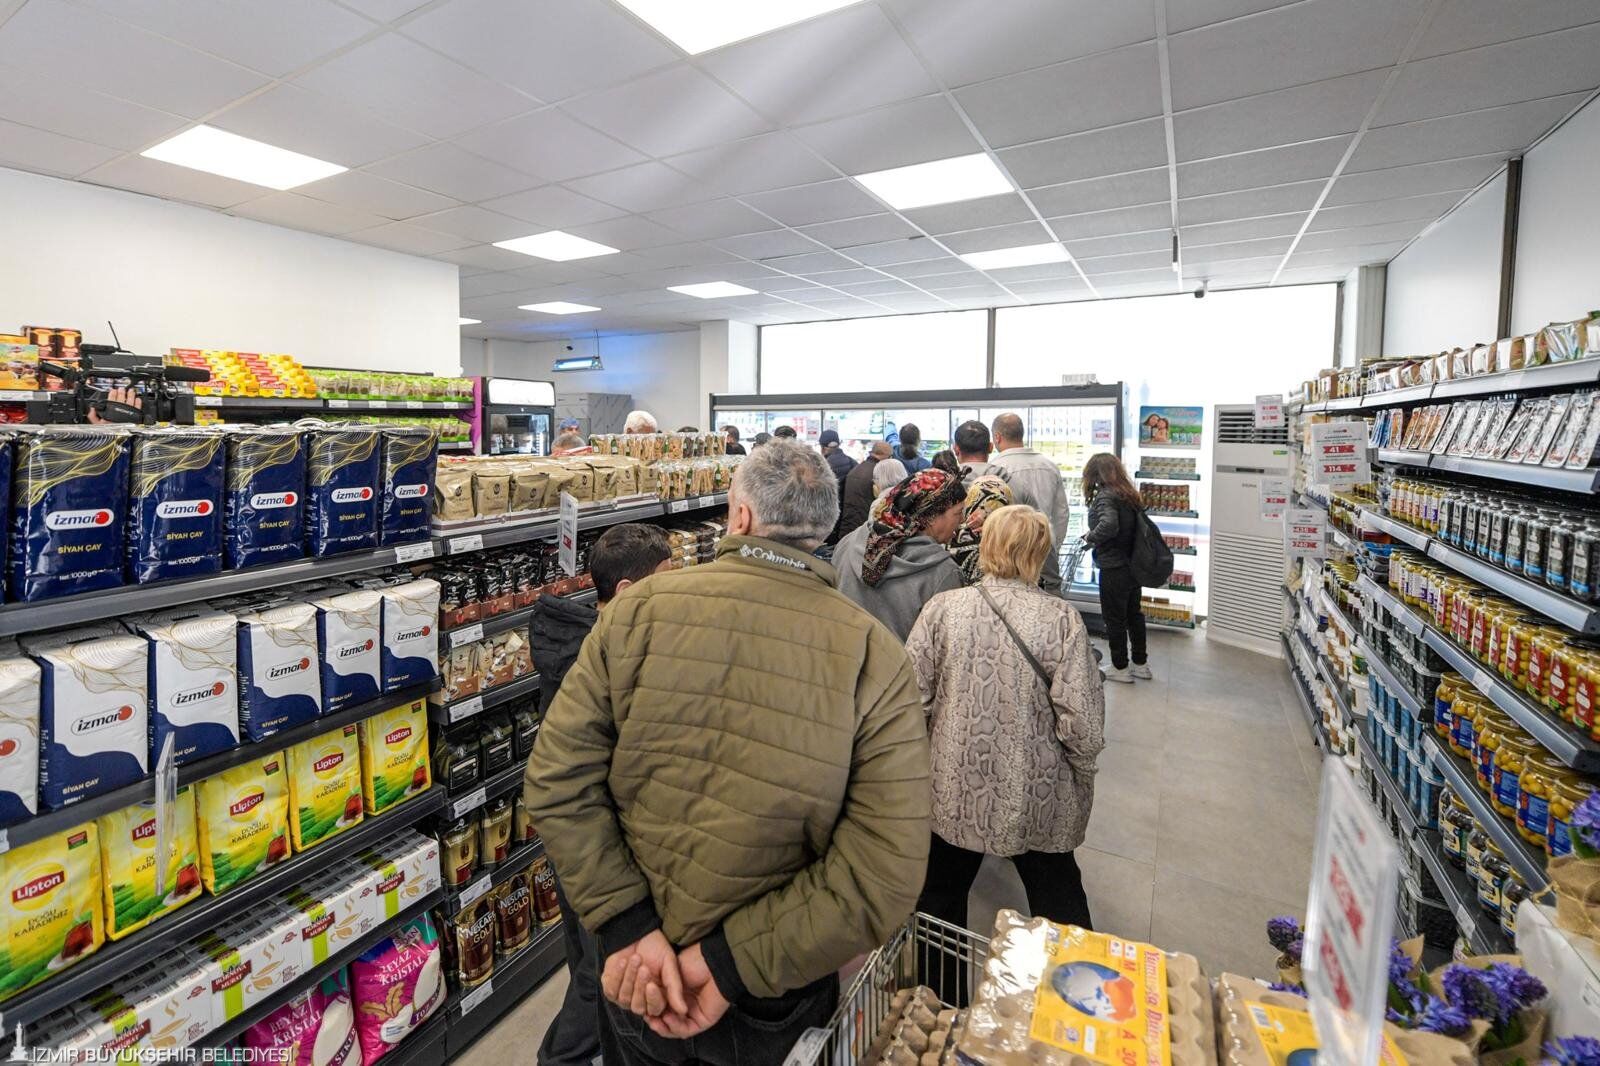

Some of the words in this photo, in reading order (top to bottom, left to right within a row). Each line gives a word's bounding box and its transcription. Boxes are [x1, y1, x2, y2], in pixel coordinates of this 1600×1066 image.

[163, 503, 199, 515] izmar
[256, 496, 287, 506] izmar
[54, 513, 98, 526] izmar
[259, 521, 278, 530] SİYAH
[278, 520, 290, 529] ÇAY
[166, 532, 188, 541] SİYAH
[189, 531, 204, 541] ÇAY
[58, 545, 84, 555] SİYAH
[85, 543, 102, 553] ÇAY
[752, 547, 805, 569] Columbia
[340, 644, 367, 658] izmar
[270, 664, 301, 679] izmar
[176, 686, 214, 705] izmar
[77, 711, 120, 733] izmar
[388, 729, 411, 744] Lipton
[316, 755, 342, 771] Lipton
[62, 783, 85, 796] SİYAH
[85, 777, 99, 789] ÇAY
[233, 794, 263, 814] Lipton
[231, 822, 270, 845] KARADENİZ
[241, 821, 262, 834] DOĞU
[16, 874, 62, 900] Lipton
[508, 897, 529, 915] GOLD
[14, 908, 69, 939] KARADENİZ
[27, 908, 57, 926] DOĞU
[474, 923, 494, 943] GOLD
[381, 956, 425, 986] KRİSTAL
[270, 1005, 309, 1032] BEYAZ
[1122, 1047, 1135, 1066] 30
